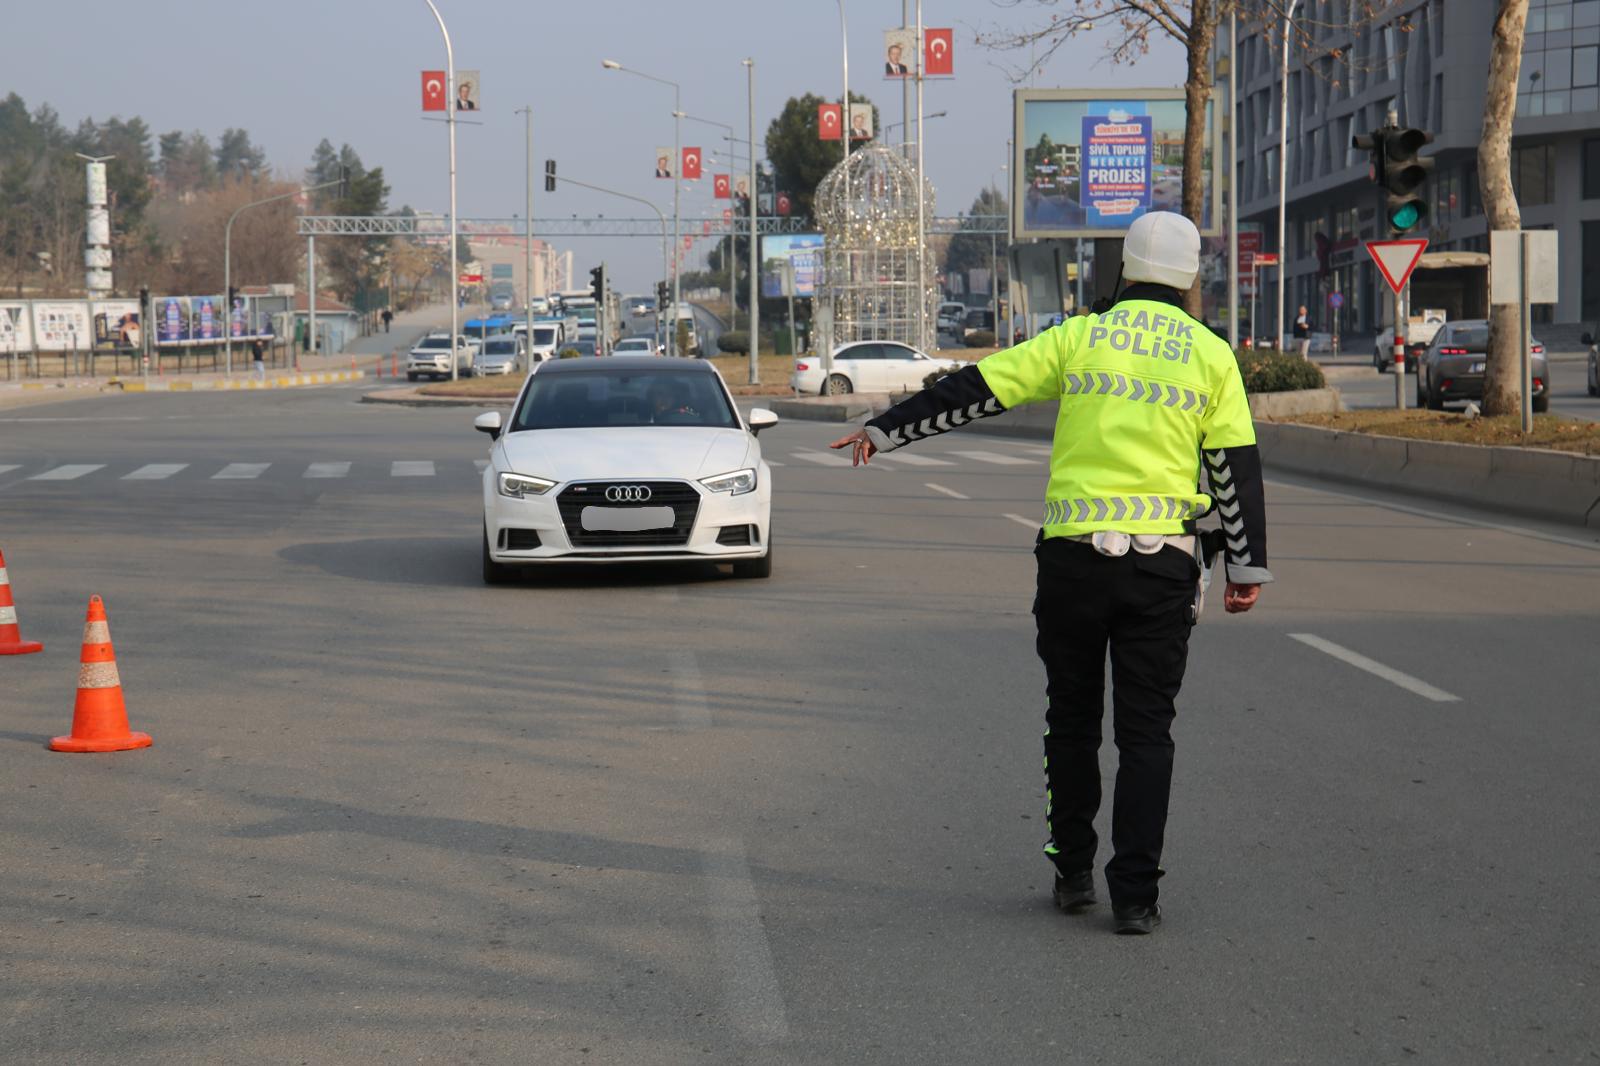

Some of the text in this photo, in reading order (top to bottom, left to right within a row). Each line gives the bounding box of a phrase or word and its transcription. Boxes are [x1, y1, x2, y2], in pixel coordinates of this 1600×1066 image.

[1089, 143, 1146, 155] SİVİL TOPLUM
[1090, 156, 1145, 167] MERKEZİ
[1088, 167, 1146, 184] PROJESİ
